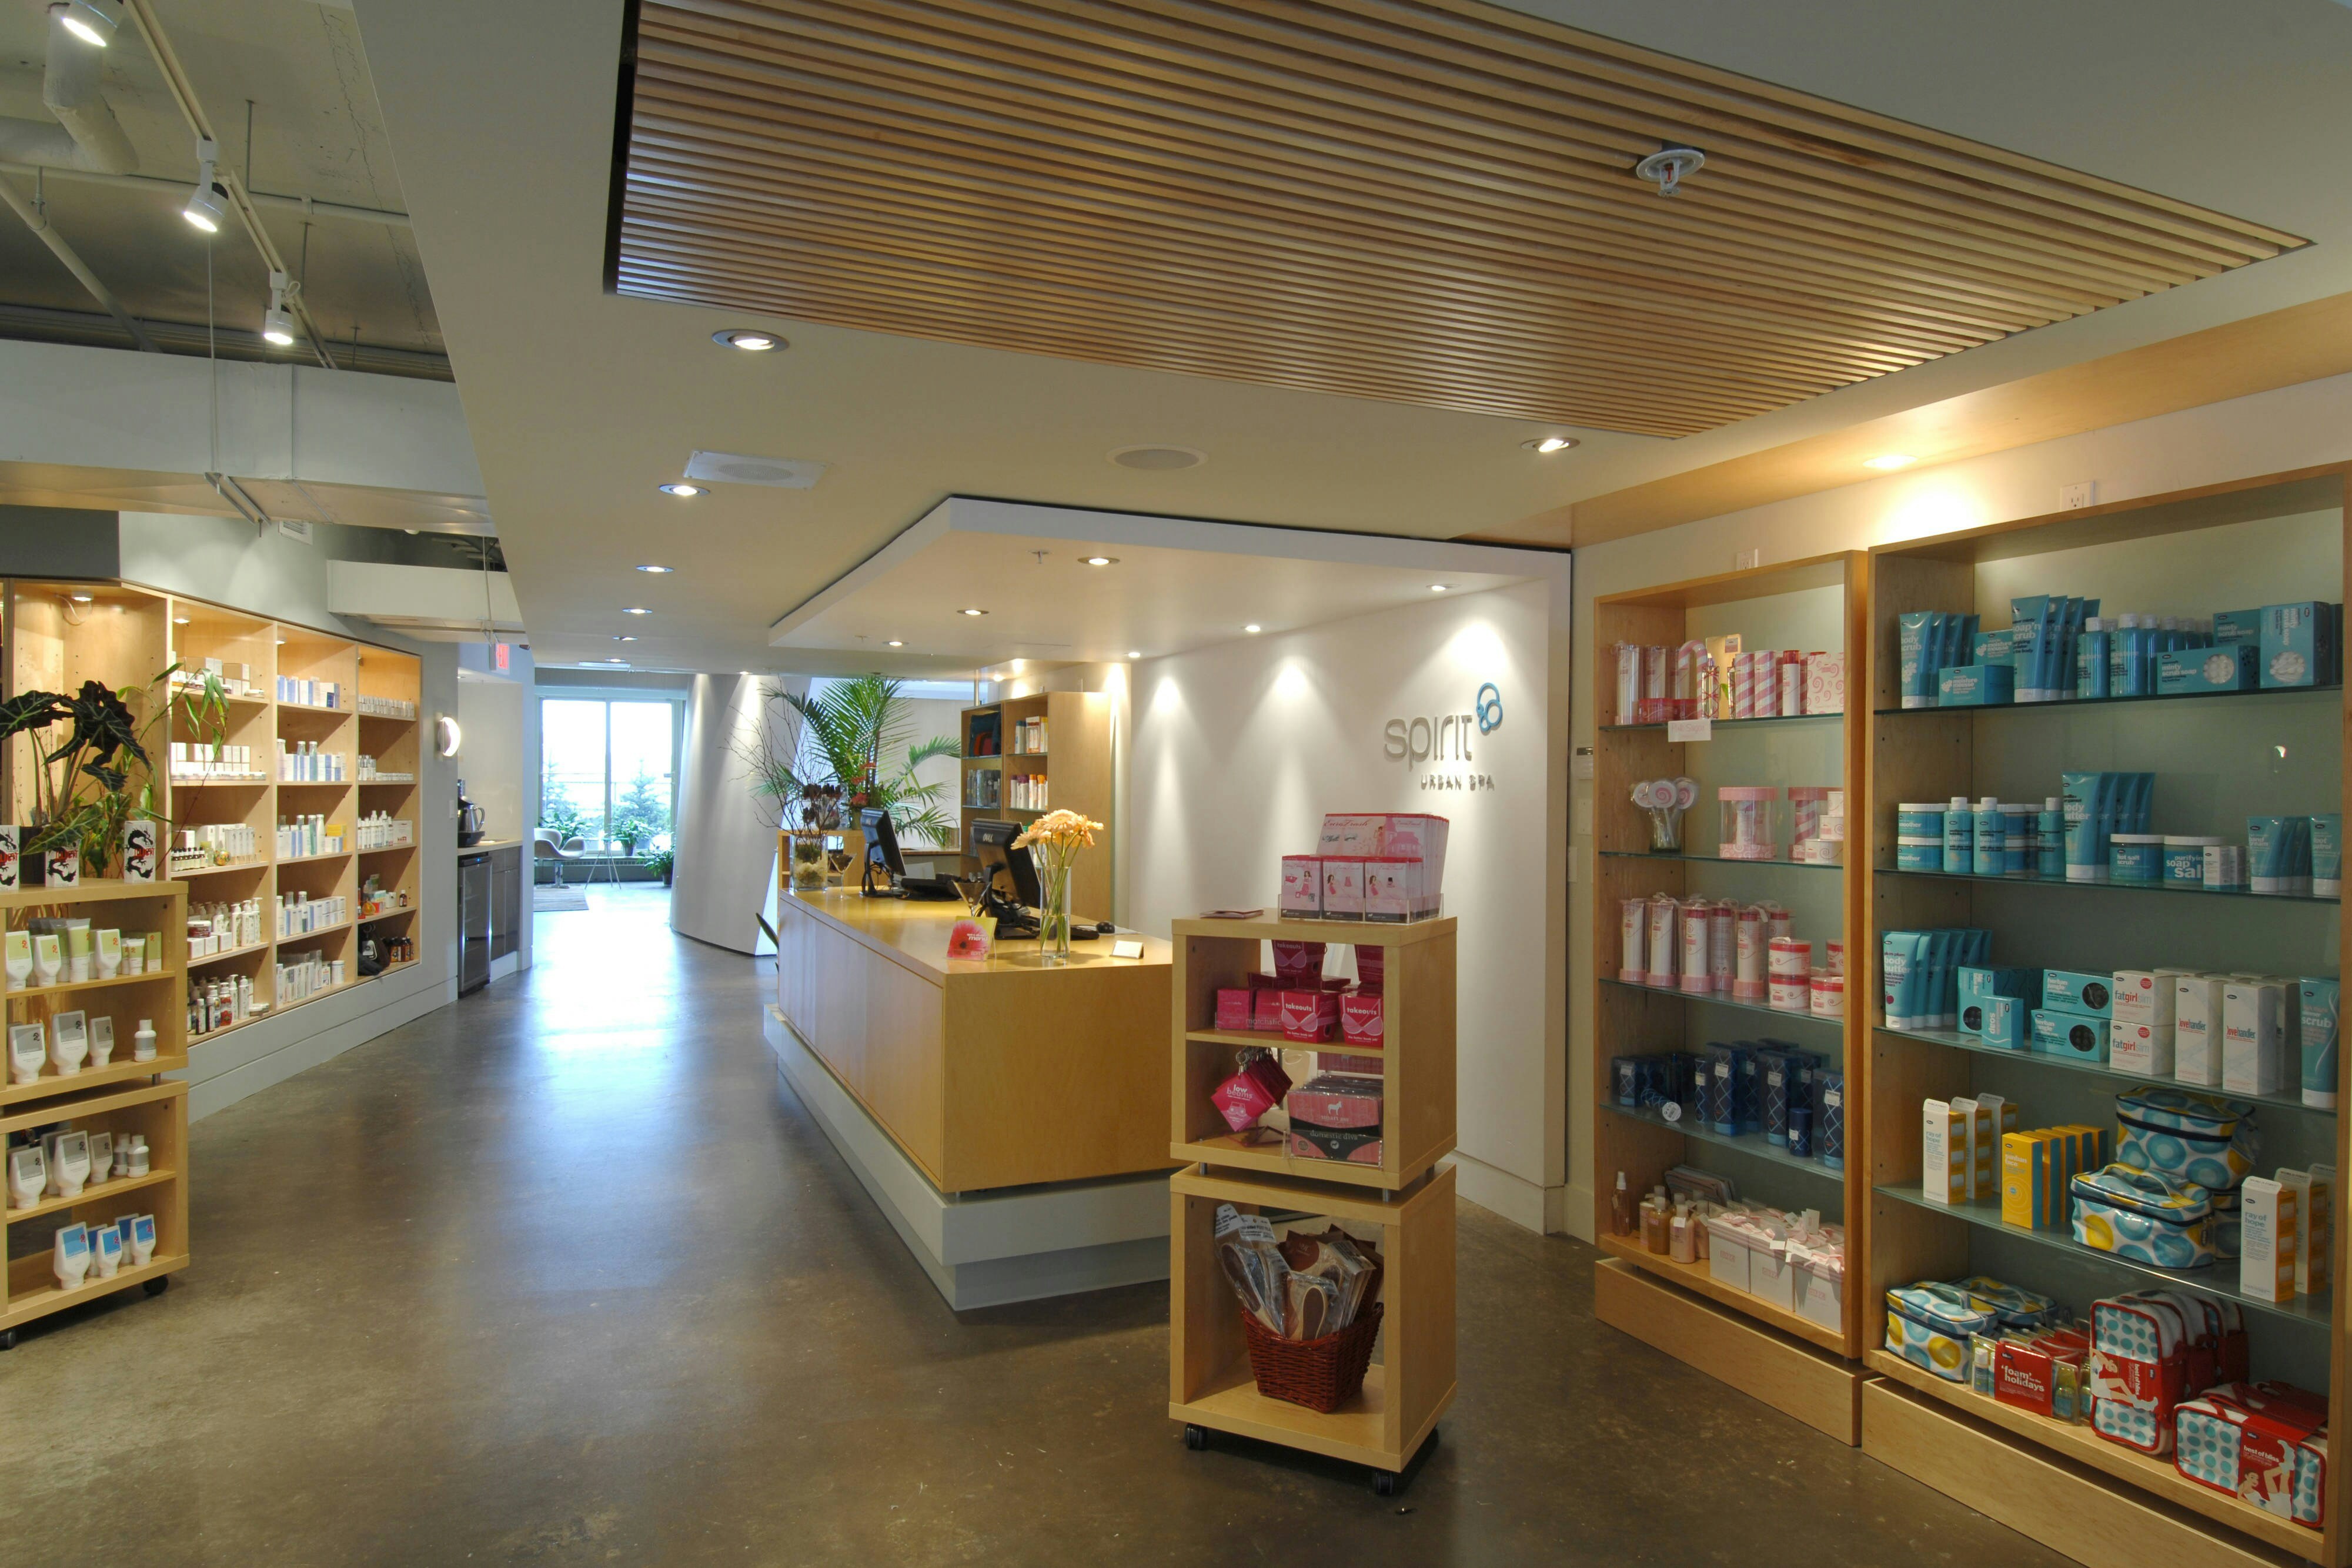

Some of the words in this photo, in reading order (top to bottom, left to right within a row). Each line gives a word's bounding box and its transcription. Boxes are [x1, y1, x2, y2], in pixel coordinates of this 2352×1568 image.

[1385, 715, 1473, 772] spirit
[1421, 774, 1462, 790] URBAN
[1469, 774, 1495, 791] SPA
[2166, 860, 2190, 869] soap
[2174, 865, 2204, 878] sal
[1884, 956, 1906, 967] body
[1285, 1003, 1312, 1011] takeouts
[1347, 1007, 1377, 1015] takeouts
[2301, 1017, 2333, 1028] scrub
[1234, 1084, 1247, 1093] low
[1310, 1130, 1342, 1139] domestic
[2245, 1212, 2259, 1221] ray
[2244, 1218, 2265, 1228] hope
[2004, 1373, 2045, 1392] holidays
[2244, 1445, 2257, 1455] best
[2264, 1452, 2280, 1463] bliss
